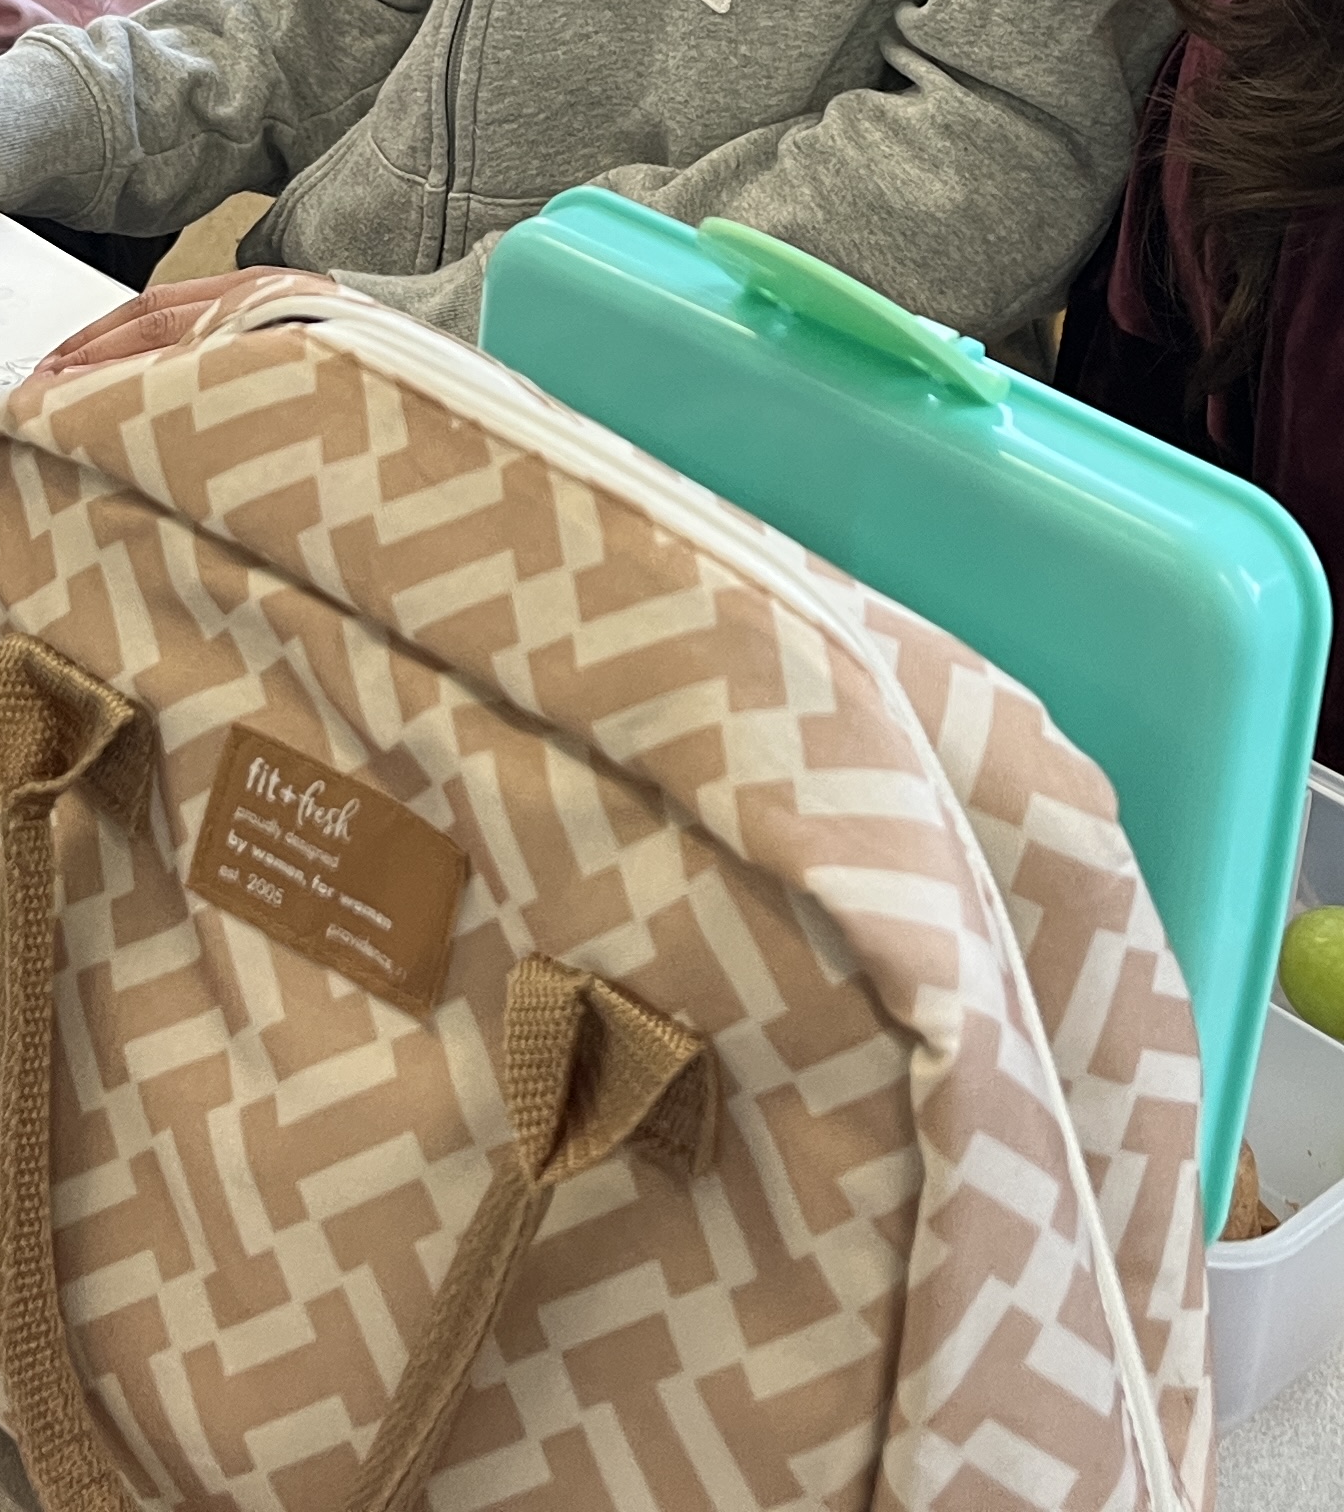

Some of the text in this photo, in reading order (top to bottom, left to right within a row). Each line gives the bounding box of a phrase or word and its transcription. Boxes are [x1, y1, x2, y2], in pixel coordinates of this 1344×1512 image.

[227, 828, 248, 853] by
[312, 874, 335, 897] for
[339, 893, 393, 931] women
